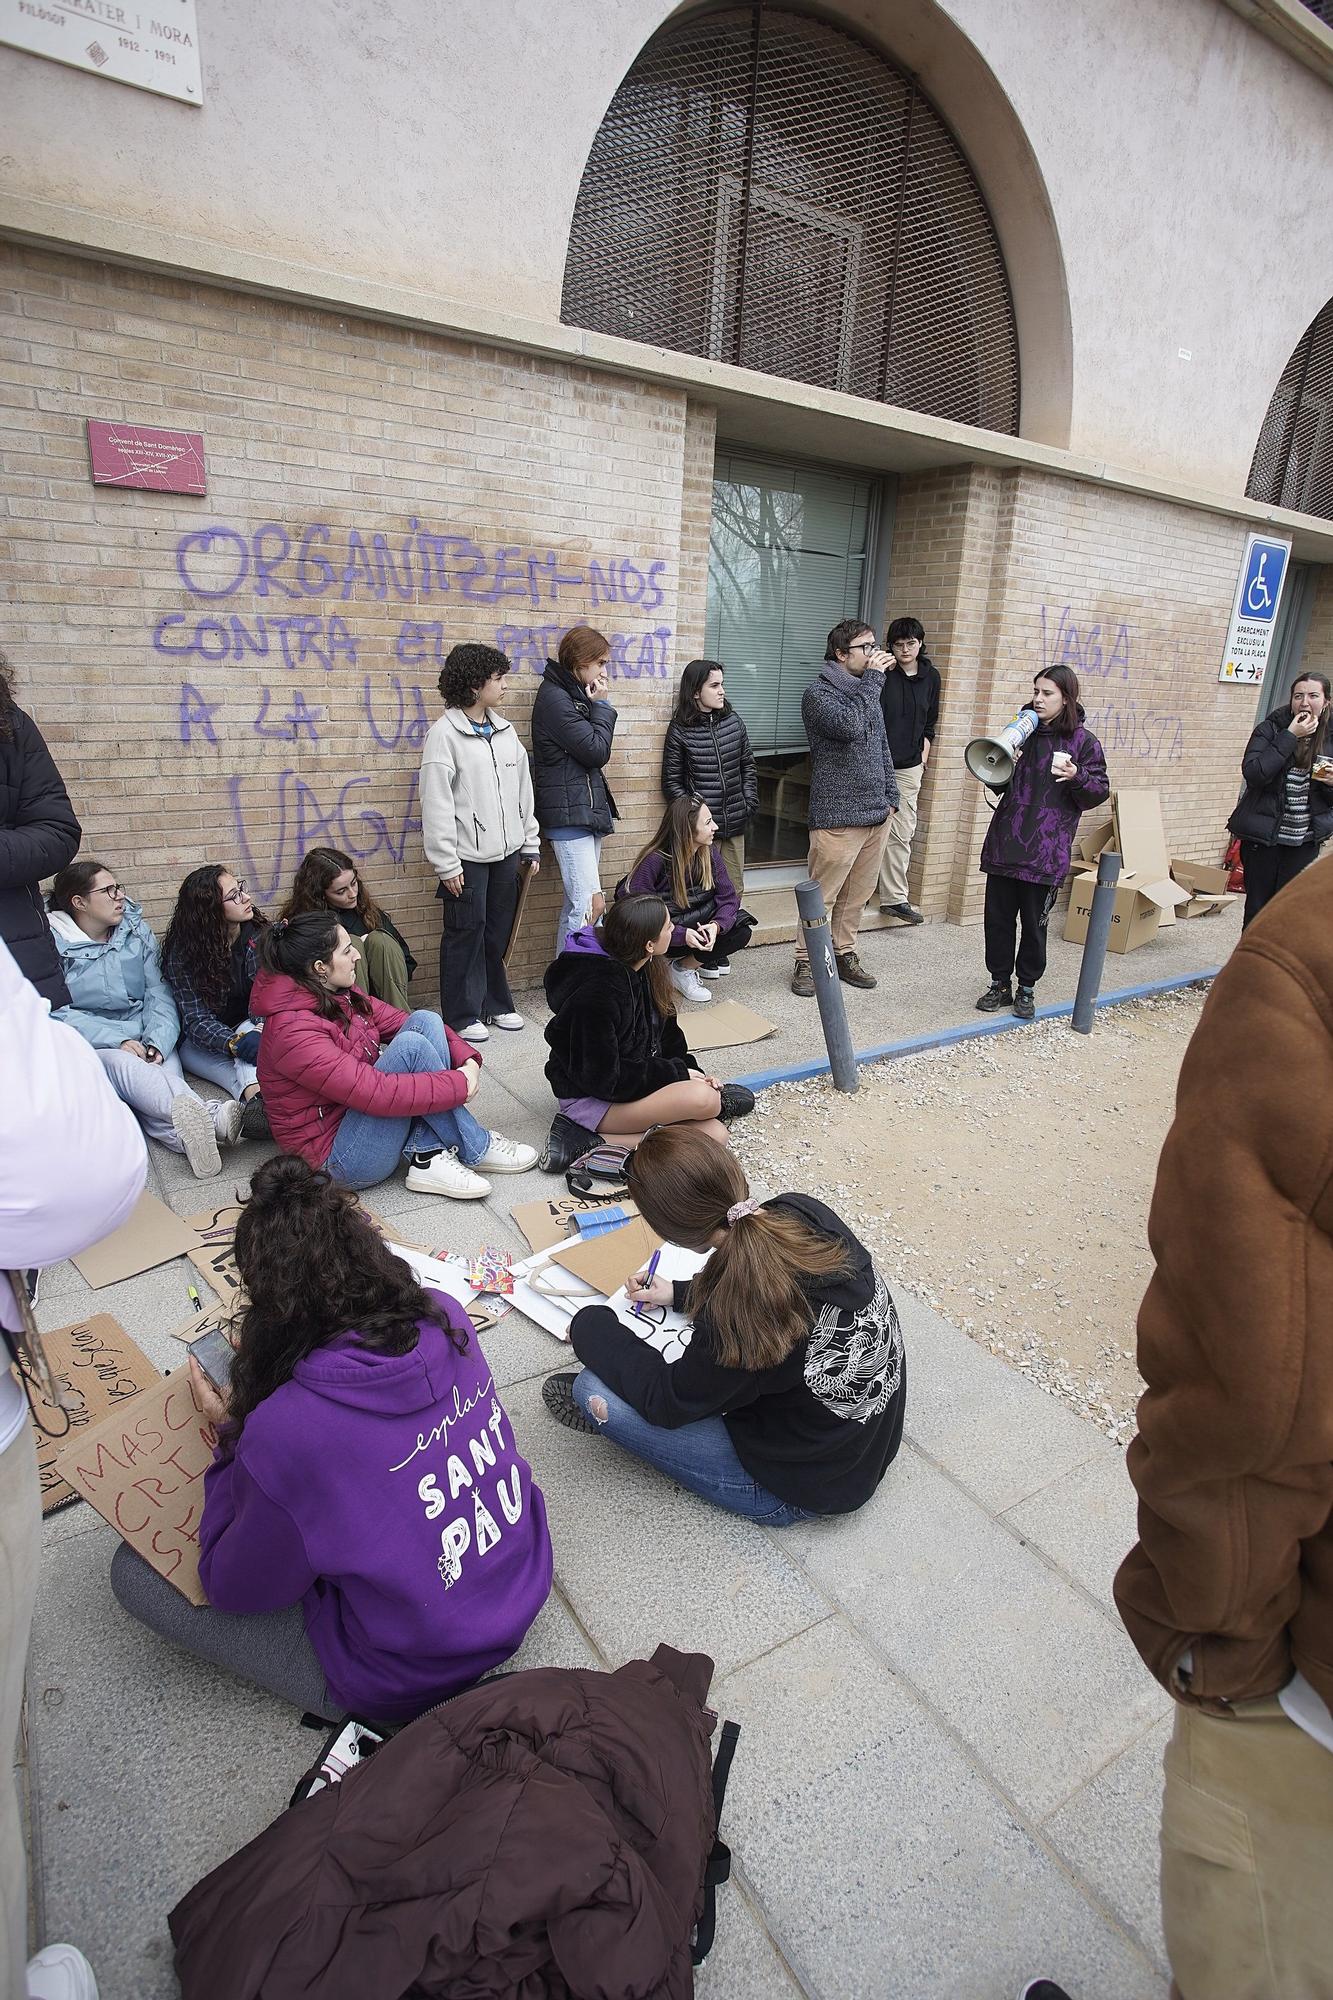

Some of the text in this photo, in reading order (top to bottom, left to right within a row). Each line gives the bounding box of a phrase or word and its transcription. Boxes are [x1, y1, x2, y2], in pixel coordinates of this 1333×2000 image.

[118, 37, 140, 52] 1912
[154, 49, 176, 65] 1991
[150, 20, 193, 48] MORA
[153, 613, 362, 670] CONTRA
[1041, 603, 1130, 680] VAGA
[1231, 647, 1243, 656] TOTA
[1243, 648, 1251, 657] LA
[1236, 626, 1270, 638] APARCAMENT
[1236, 636, 1261, 647] EXCLUSIU
[180, 682, 219, 747] A
[253, 687, 323, 742] LA
[389, 1377, 493, 1472] esplai
[418, 1398, 506, 1520] SANT
[440, 1464, 523, 1586] PAU
